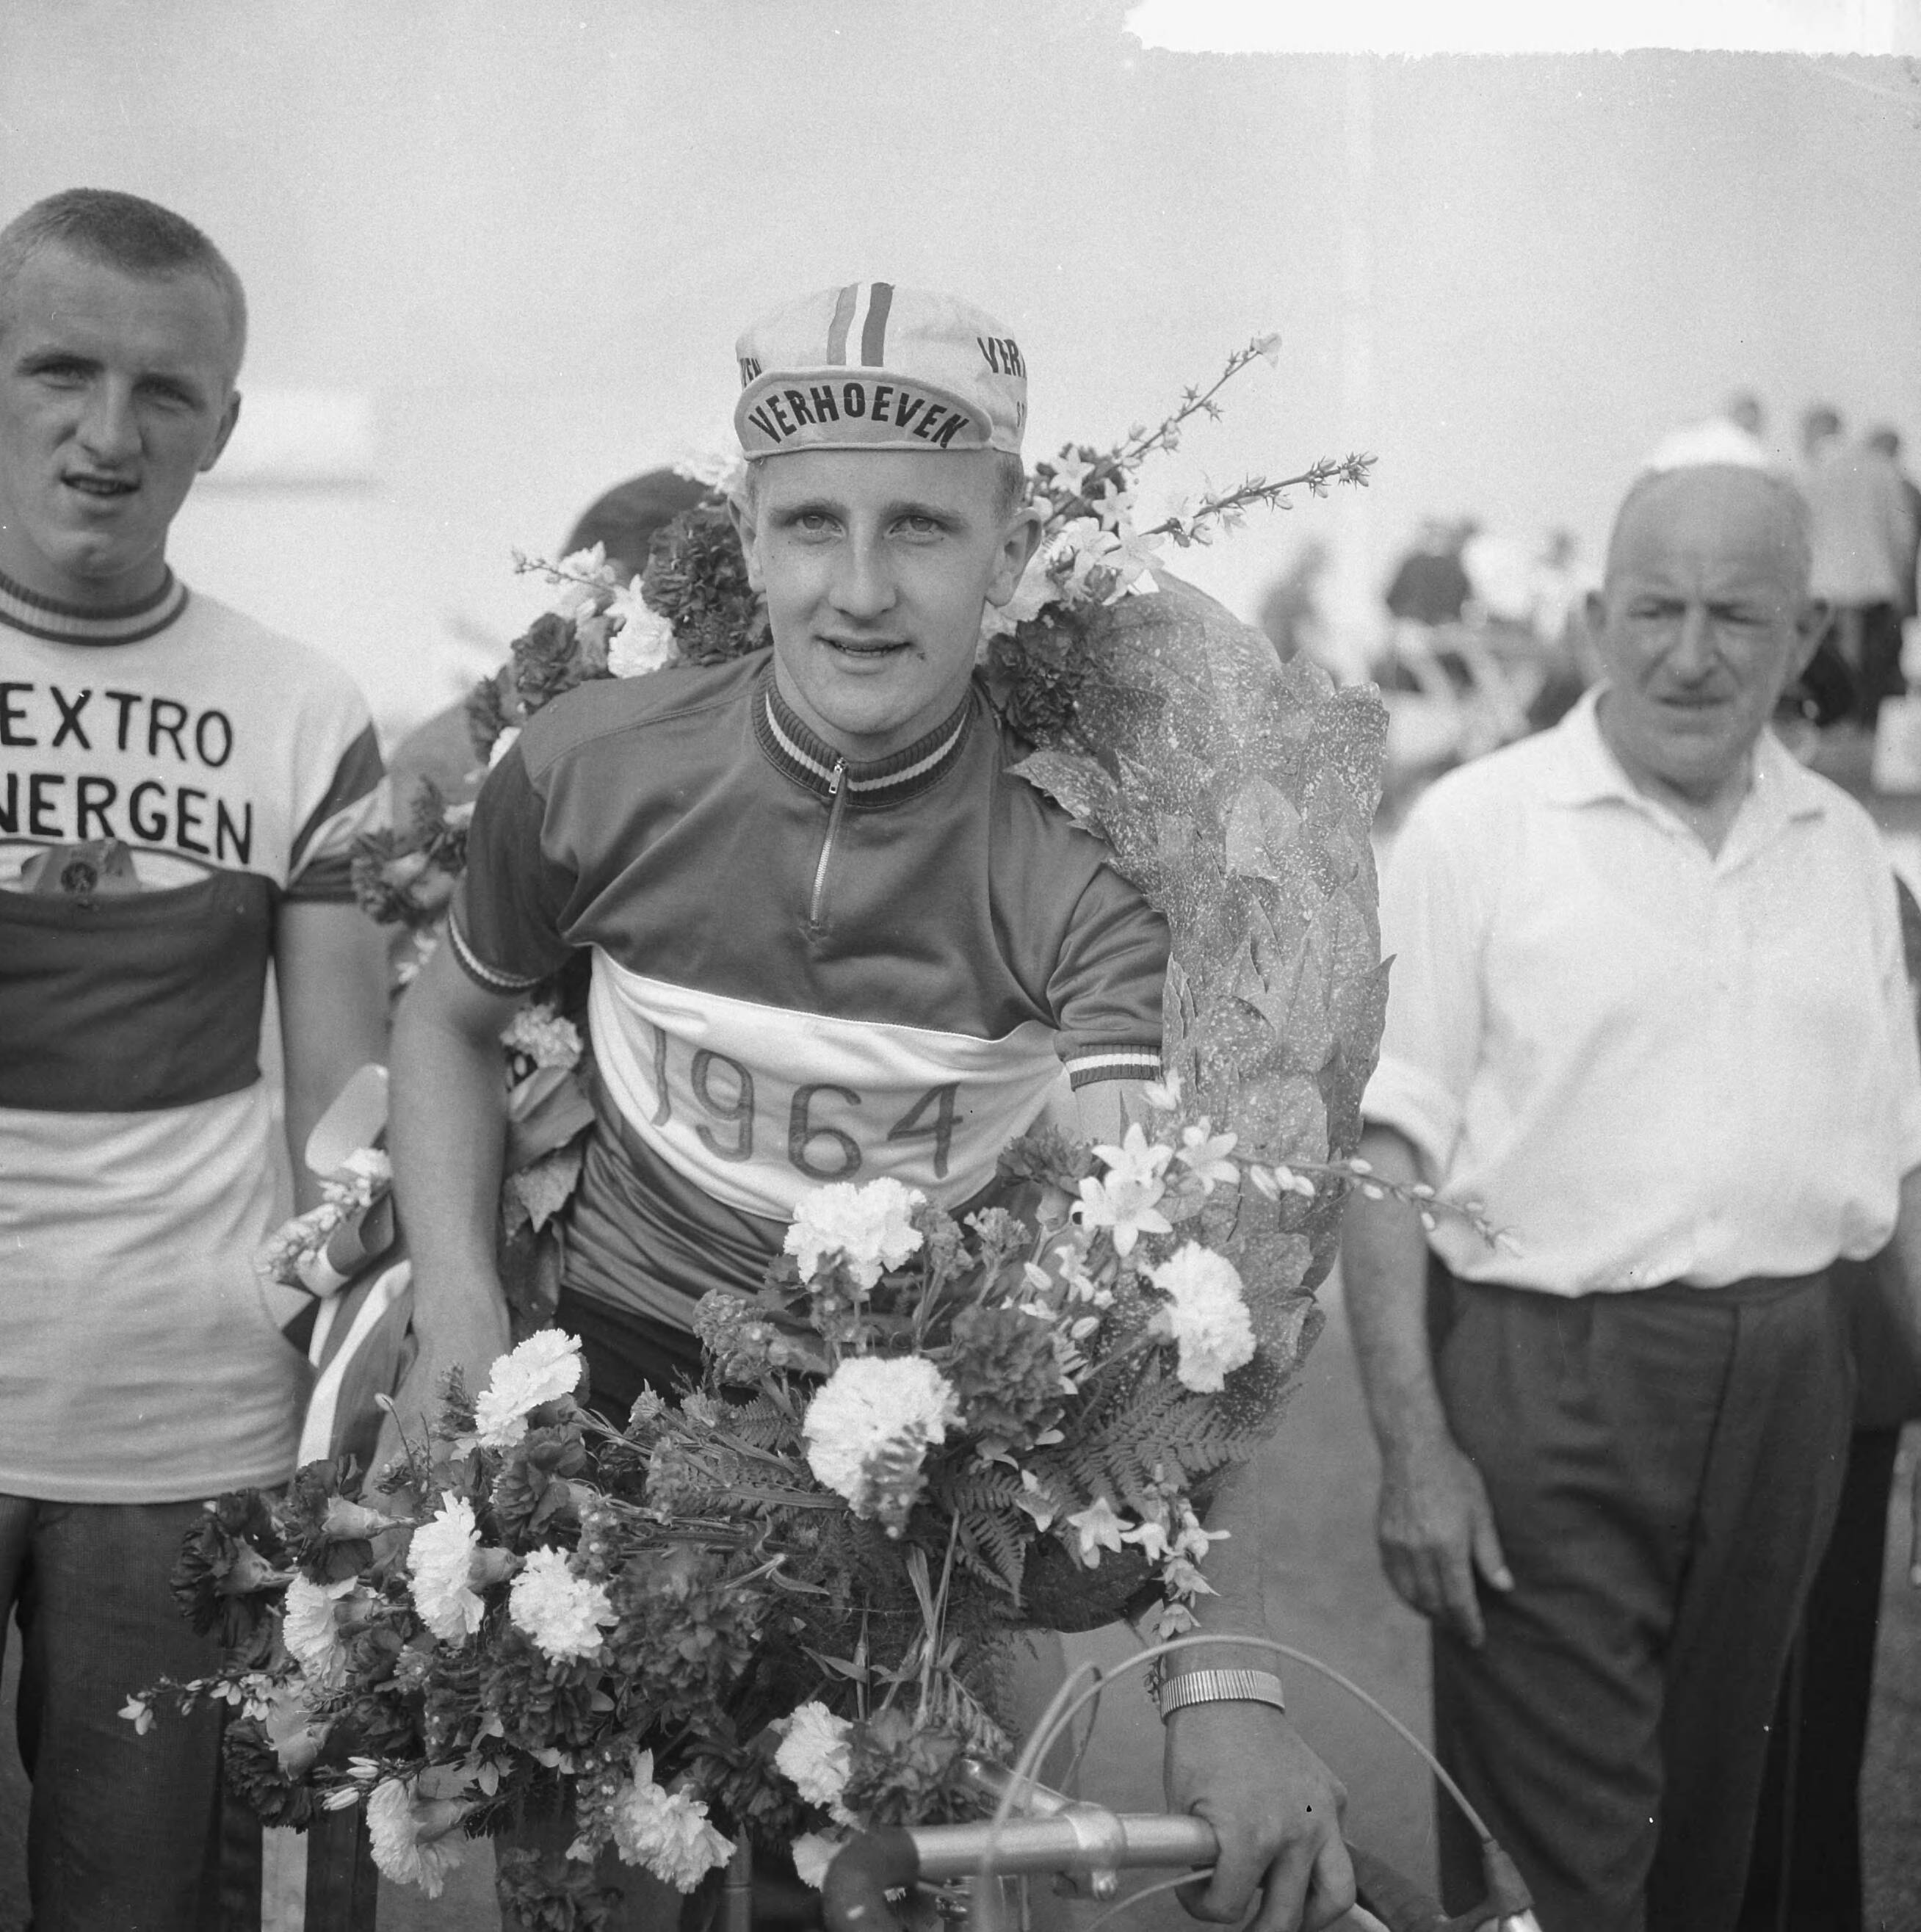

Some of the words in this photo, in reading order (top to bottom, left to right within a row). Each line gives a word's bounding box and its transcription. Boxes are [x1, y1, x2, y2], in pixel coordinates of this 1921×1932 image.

[748, 383, 969, 449] VERHOEVEN
[0, 683, 231, 767] EXTRO
[652, 1026, 963, 1180] 1964
